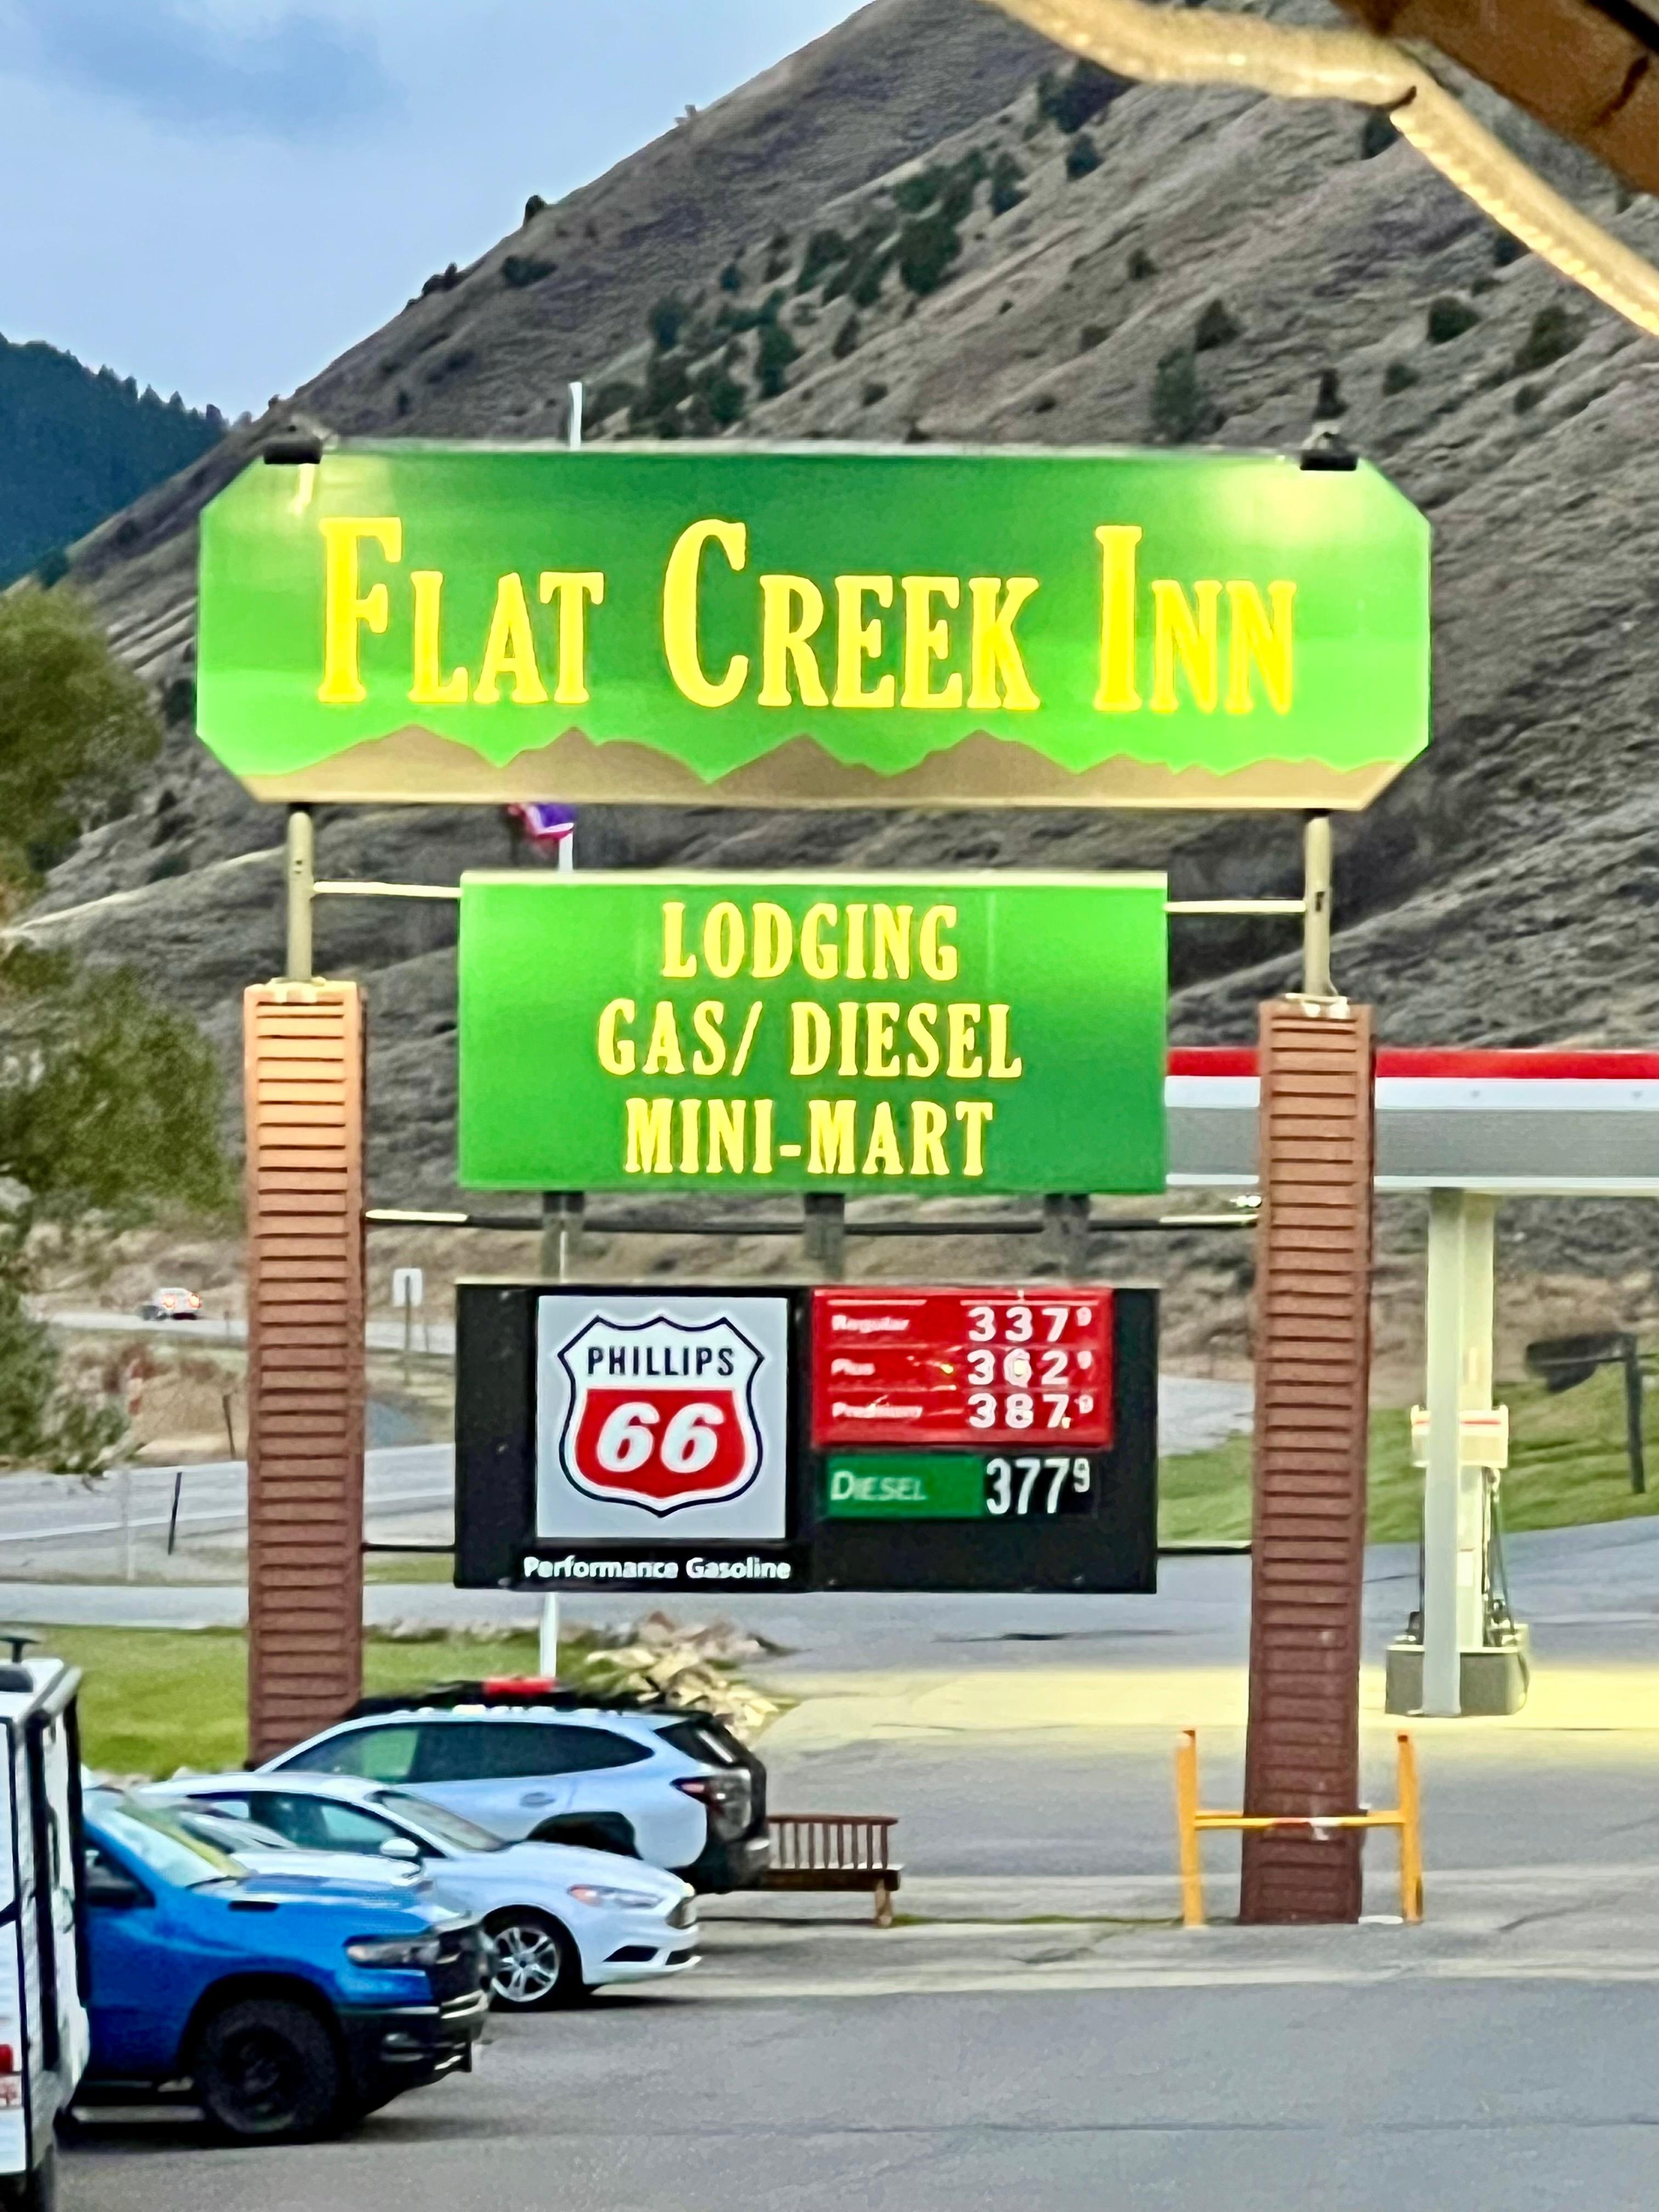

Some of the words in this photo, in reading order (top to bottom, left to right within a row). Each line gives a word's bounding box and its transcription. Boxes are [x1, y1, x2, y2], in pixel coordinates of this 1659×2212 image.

[318, 516, 604, 704] FLAT
[663, 519, 1040, 711] CREEK
[1094, 524, 1297, 714] INN
[662, 902, 958, 981] LODGING
[598, 998, 763, 1076] GAS/
[791, 1002, 1022, 1079] DIESEL
[624, 1098, 994, 1176] MINI-MART
[588, 1347, 734, 1376] PHILLIPS
[596, 1402, 724, 1473] 66
[523, 1555, 679, 1578] Performance
[686, 1557, 791, 1579] Gasoline
